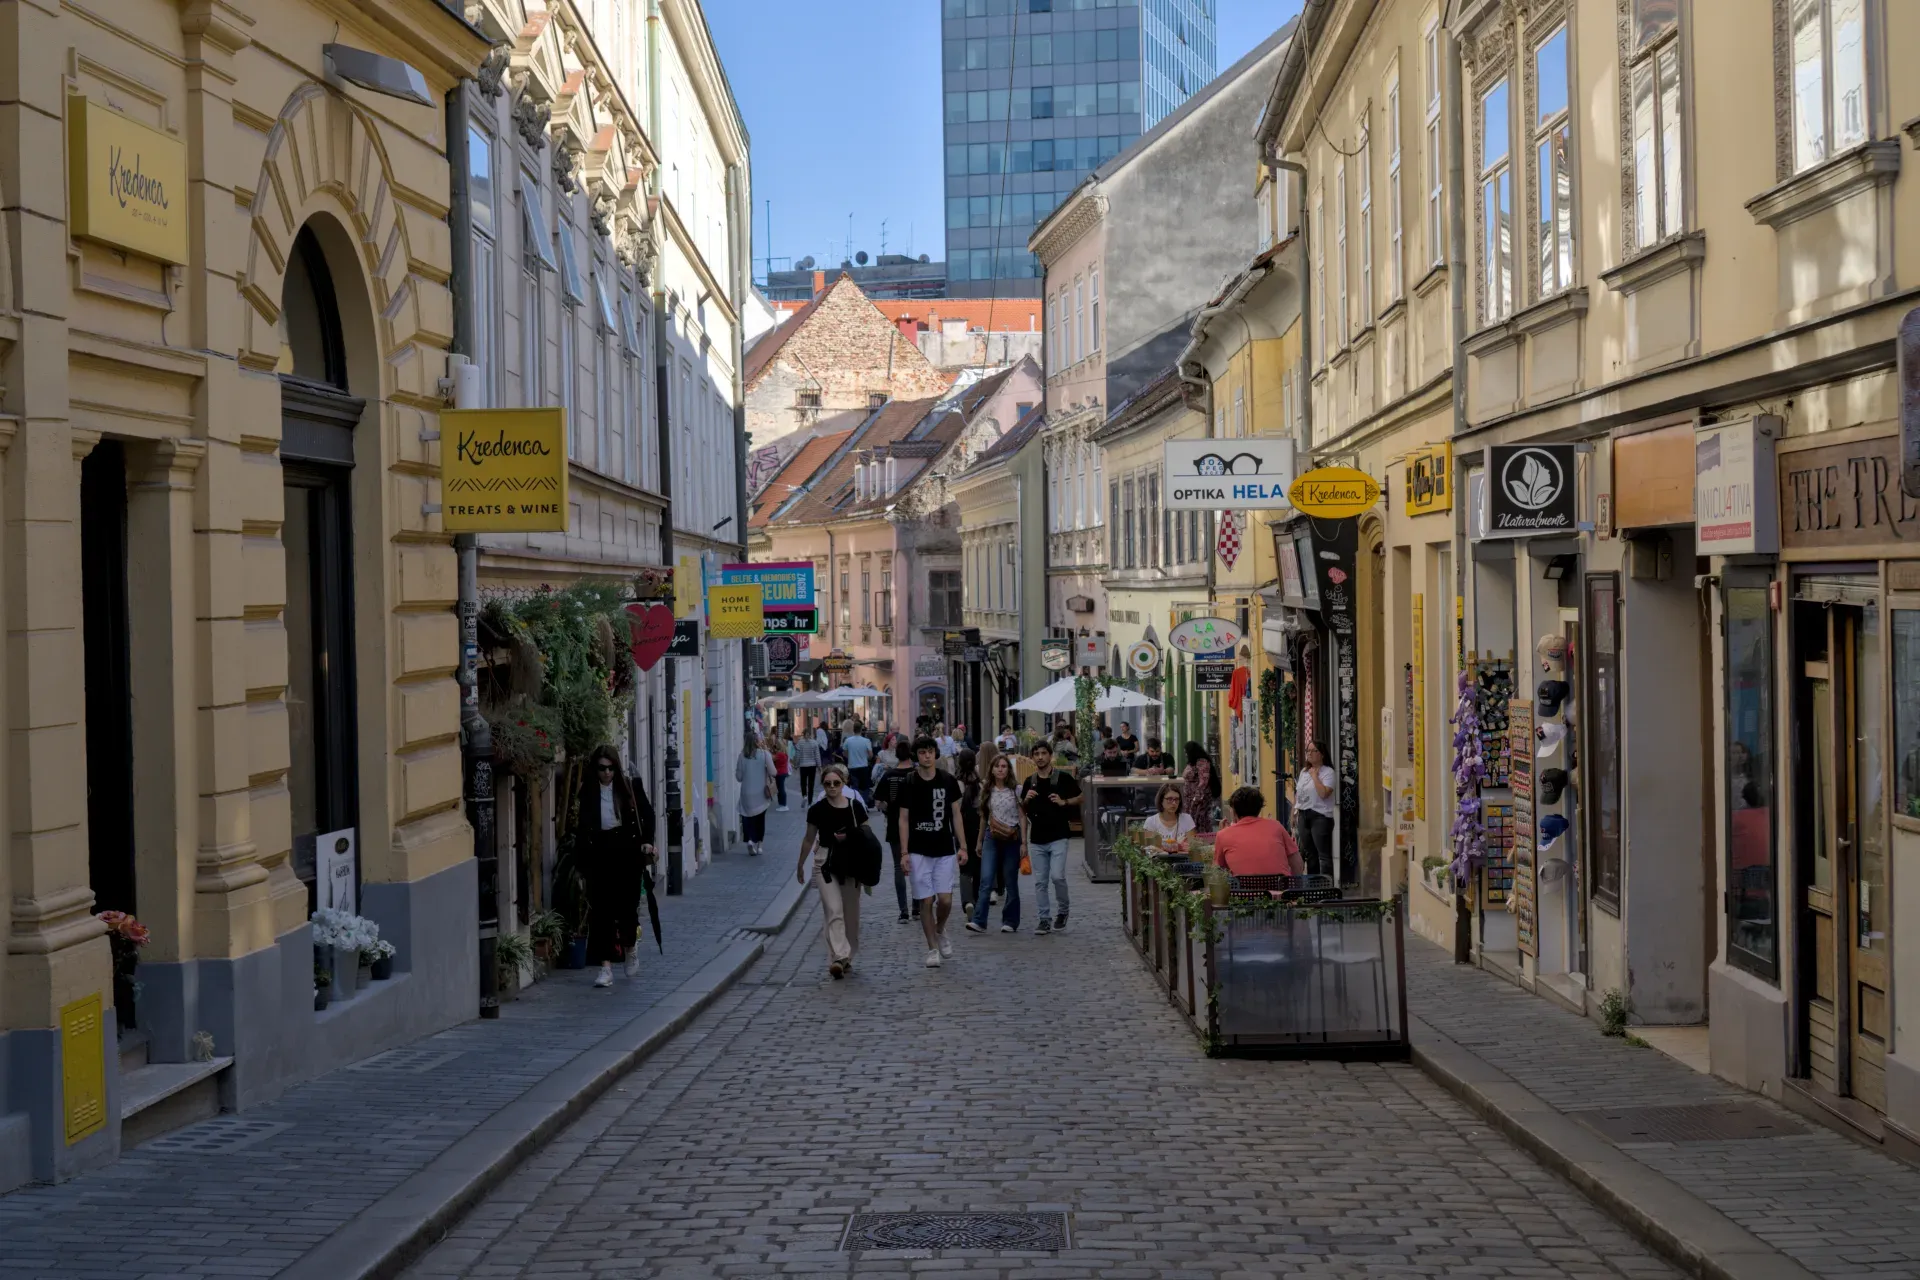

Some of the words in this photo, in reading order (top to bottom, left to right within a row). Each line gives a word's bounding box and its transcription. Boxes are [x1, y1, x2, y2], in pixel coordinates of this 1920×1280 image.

[109, 144, 168, 210] Kredenca
[457, 429, 551, 466] Kredenca
[1173, 488, 1225, 500] OPTIKA
[1233, 484, 1284, 499] HELA
[1309, 484, 1361, 503] Kredenca
[1789, 466, 1841, 532] THE
[449, 505, 502, 515] TREATS
[507, 504, 516, 514] &
[521, 504, 559, 514] WINE
[1498, 511, 1568, 529] Naturalmente
[731, 574, 753, 583] SELFIE
[753, 574, 760, 582] &
[760, 573, 796, 582] MEMORIES
[797, 573, 807, 600] ZAGREB
[721, 596, 750, 604] HOME
[722, 605, 751, 614] STYLE
[794, 615, 809, 628] hr
[1194, 622, 1216, 634] LA
[672, 634, 690, 648] ya
[1177, 632, 1236, 649] ROCKA
[933, 788, 946, 831] 2004
[1400, 823, 1415, 831] ORAN
